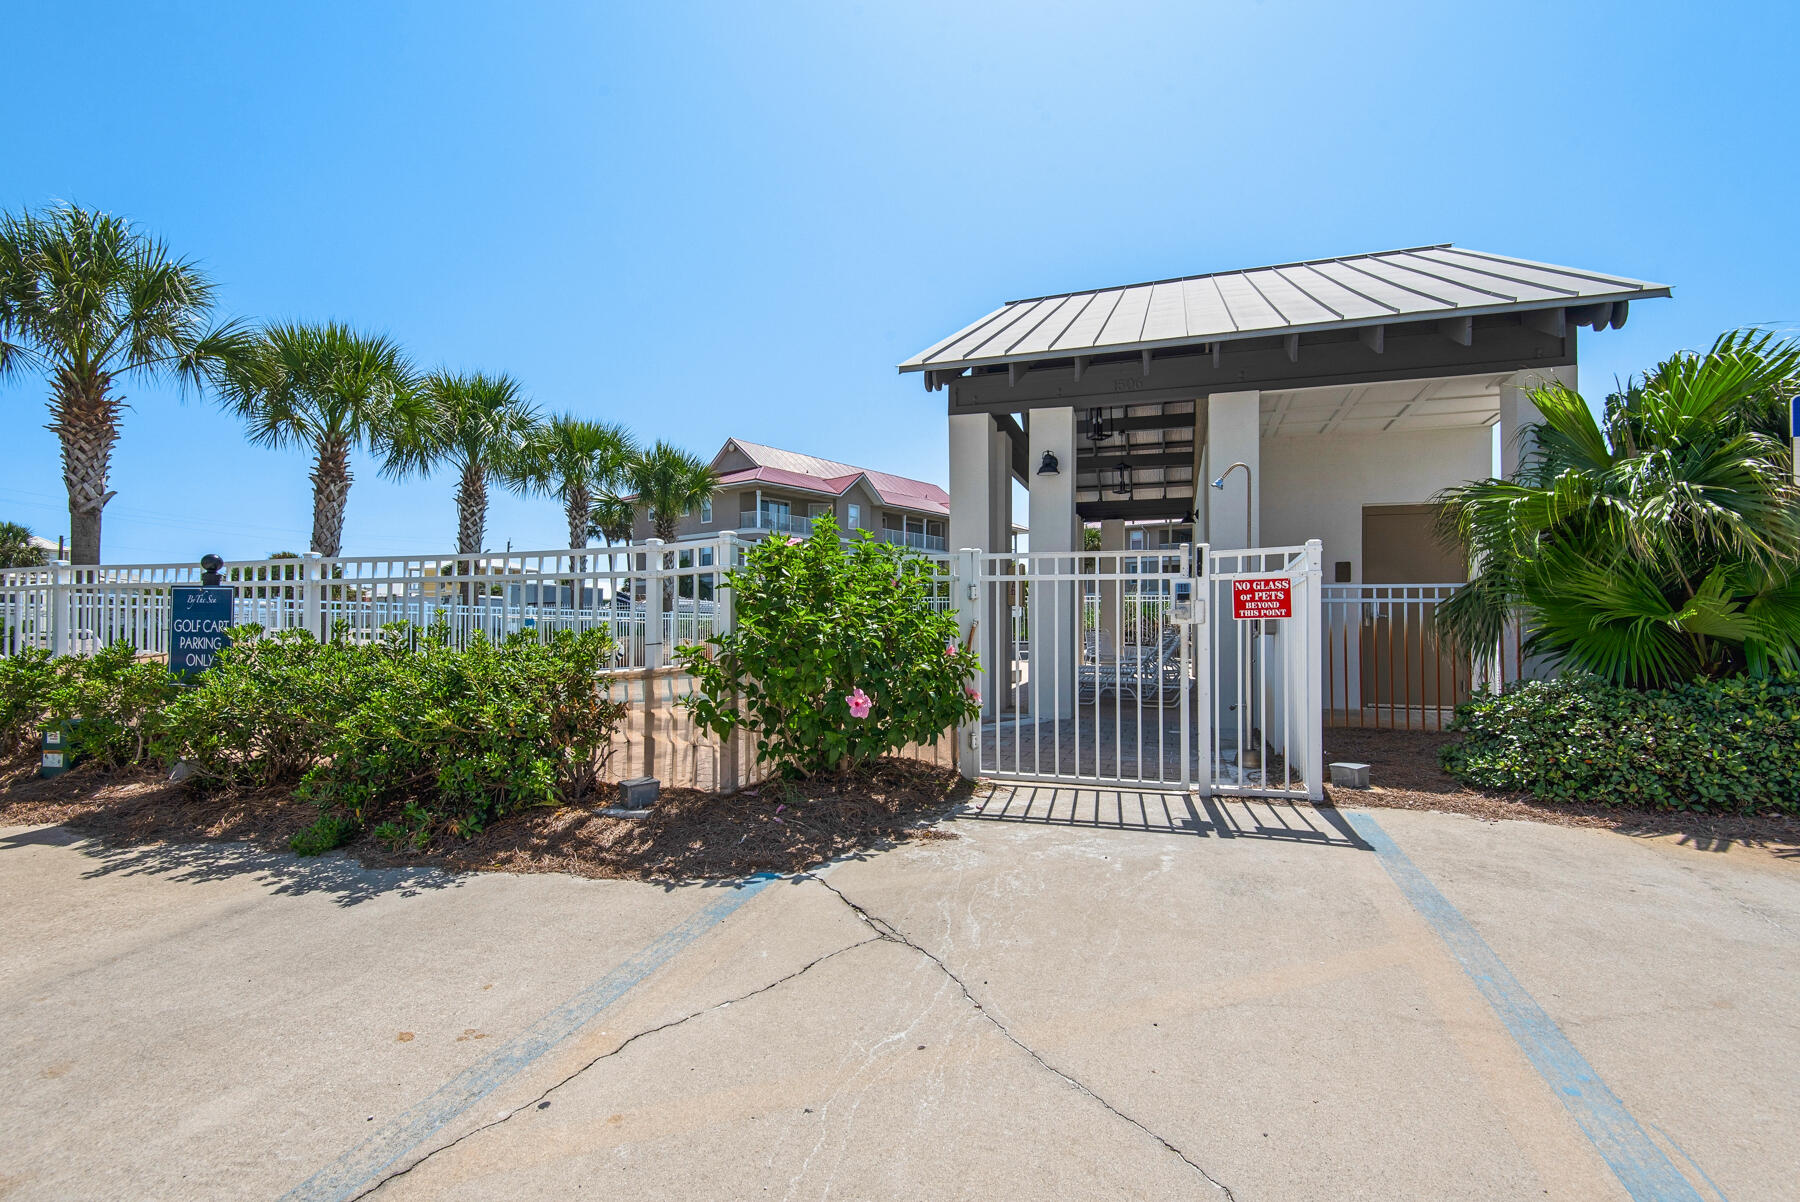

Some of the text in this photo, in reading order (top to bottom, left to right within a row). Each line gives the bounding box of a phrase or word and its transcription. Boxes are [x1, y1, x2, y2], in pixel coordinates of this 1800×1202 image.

[1235, 581, 1289, 590] NO GLASS
[187, 591, 217, 609] By The Sea
[1255, 591, 1284, 600] PETS
[174, 620, 230, 632] GOLF CART
[180, 637, 222, 649] PARKING
[186, 654, 215, 666] ONLY
